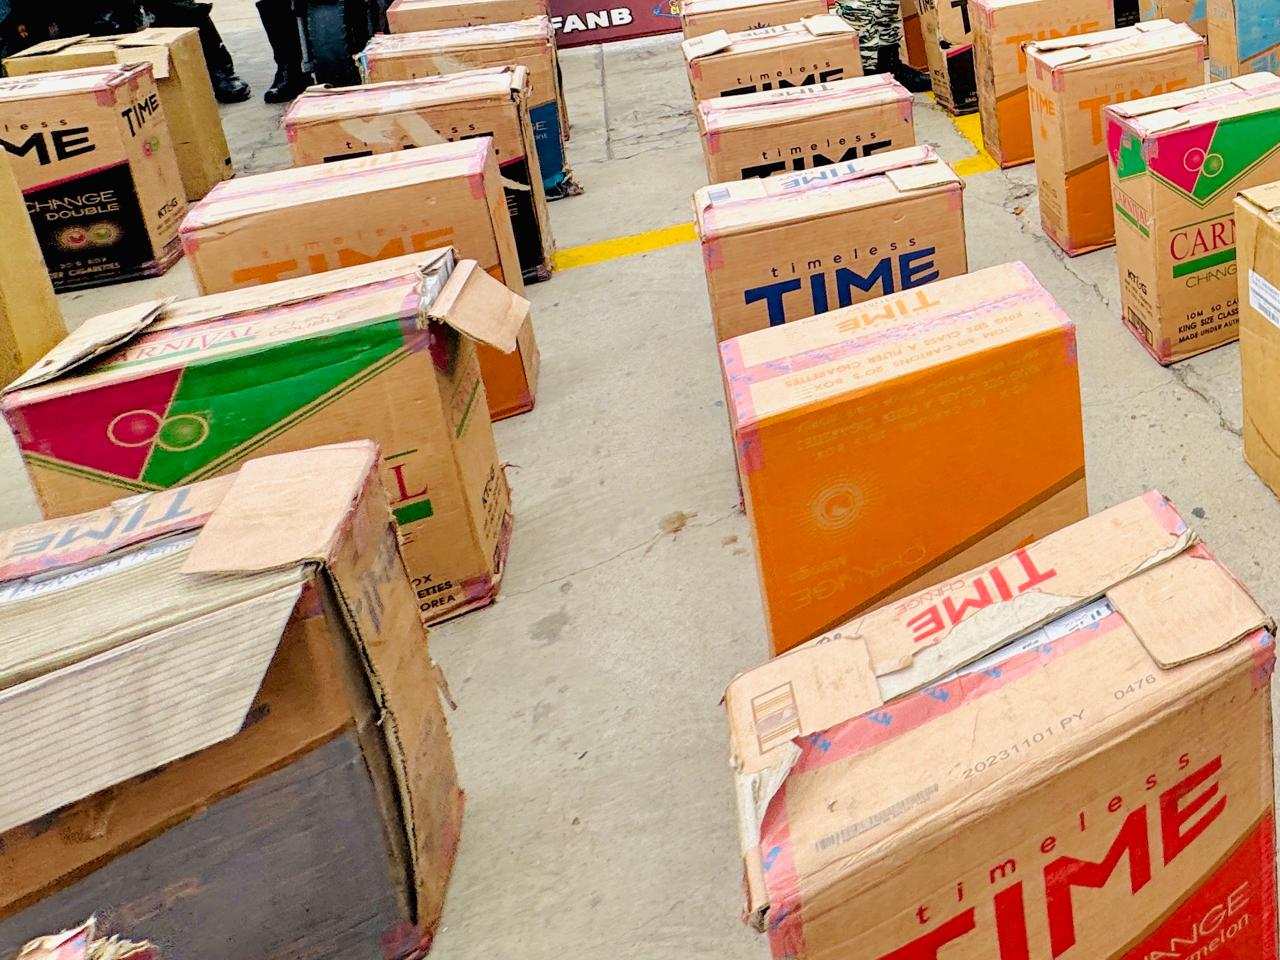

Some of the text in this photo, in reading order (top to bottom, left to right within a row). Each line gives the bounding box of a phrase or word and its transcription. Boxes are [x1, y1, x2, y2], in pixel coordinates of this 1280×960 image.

[552, 8, 633, 33] FANB
[737, 61, 831, 84] timeless
[122, 94, 159, 137] TIME
[761, 132, 877, 160] timeless
[781, 164, 864, 189] TIME
[25, 190, 118, 214] CHANGE
[46, 203, 120, 221] DOUBLE
[771, 237, 916, 277] timeless
[744, 247, 939, 327] TIME
[1186, 264, 1237, 289] CHANG
[837, 290, 941, 333] TIME
[1178, 308, 1239, 334] KING SIZE CLASS
[1178, 325, 1221, 343] MADE UNDER
[9, 487, 195, 555] TIME
[420, 594, 456, 612] OREA
[906, 548, 1057, 644] TIME
[1113, 673, 1157, 701] 0476
[963, 708, 1087, 780] 20231101 PY
[915, 752, 1190, 924] timeless
[877, 754, 1228, 960] TIME
